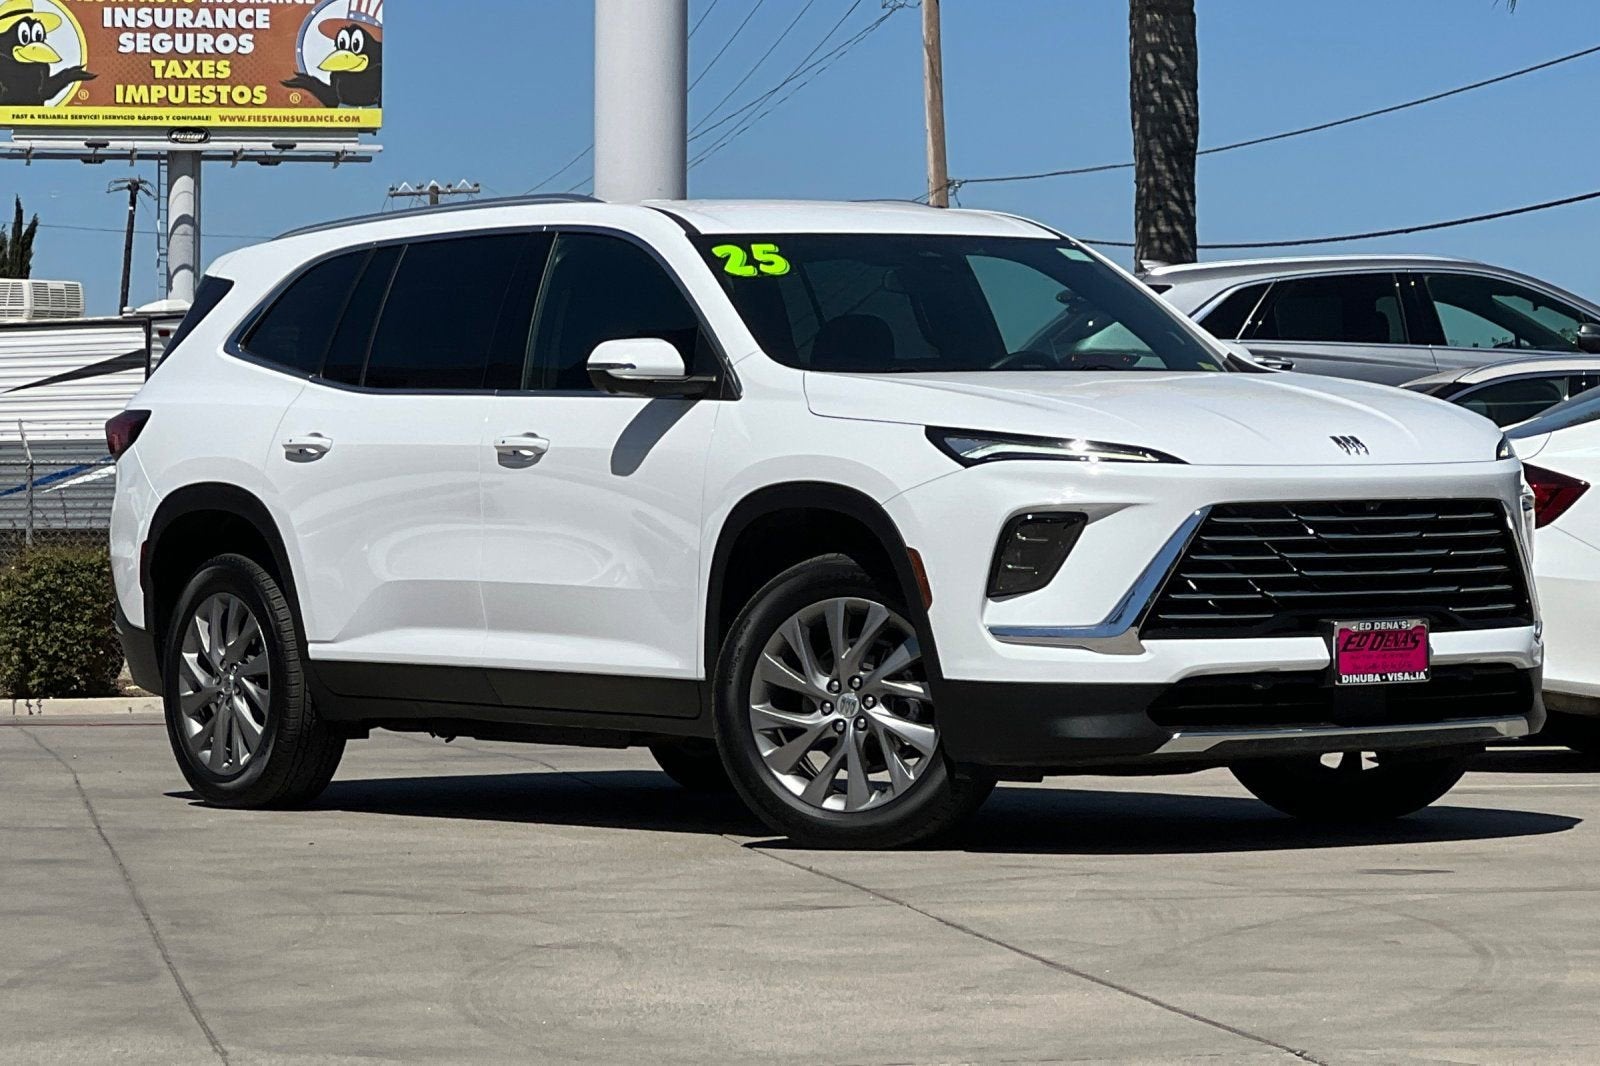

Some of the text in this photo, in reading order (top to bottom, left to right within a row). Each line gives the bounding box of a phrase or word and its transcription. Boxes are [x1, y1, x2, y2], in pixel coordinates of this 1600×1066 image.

[103, 7, 270, 28] INSURANCE
[118, 32, 255, 54] SEGUROS
[151, 59, 231, 79] TAXES
[115, 84, 267, 104] IMPUESTOS
[218, 114, 361, 123] WWW.FIESTAINSURANCE.COM
[712, 243, 790, 277] 25
[1359, 621, 1407, 630] ED DENA'S
[1341, 632, 1371, 652] ED
[1342, 671, 1426, 683] DINUBA VISALIA
